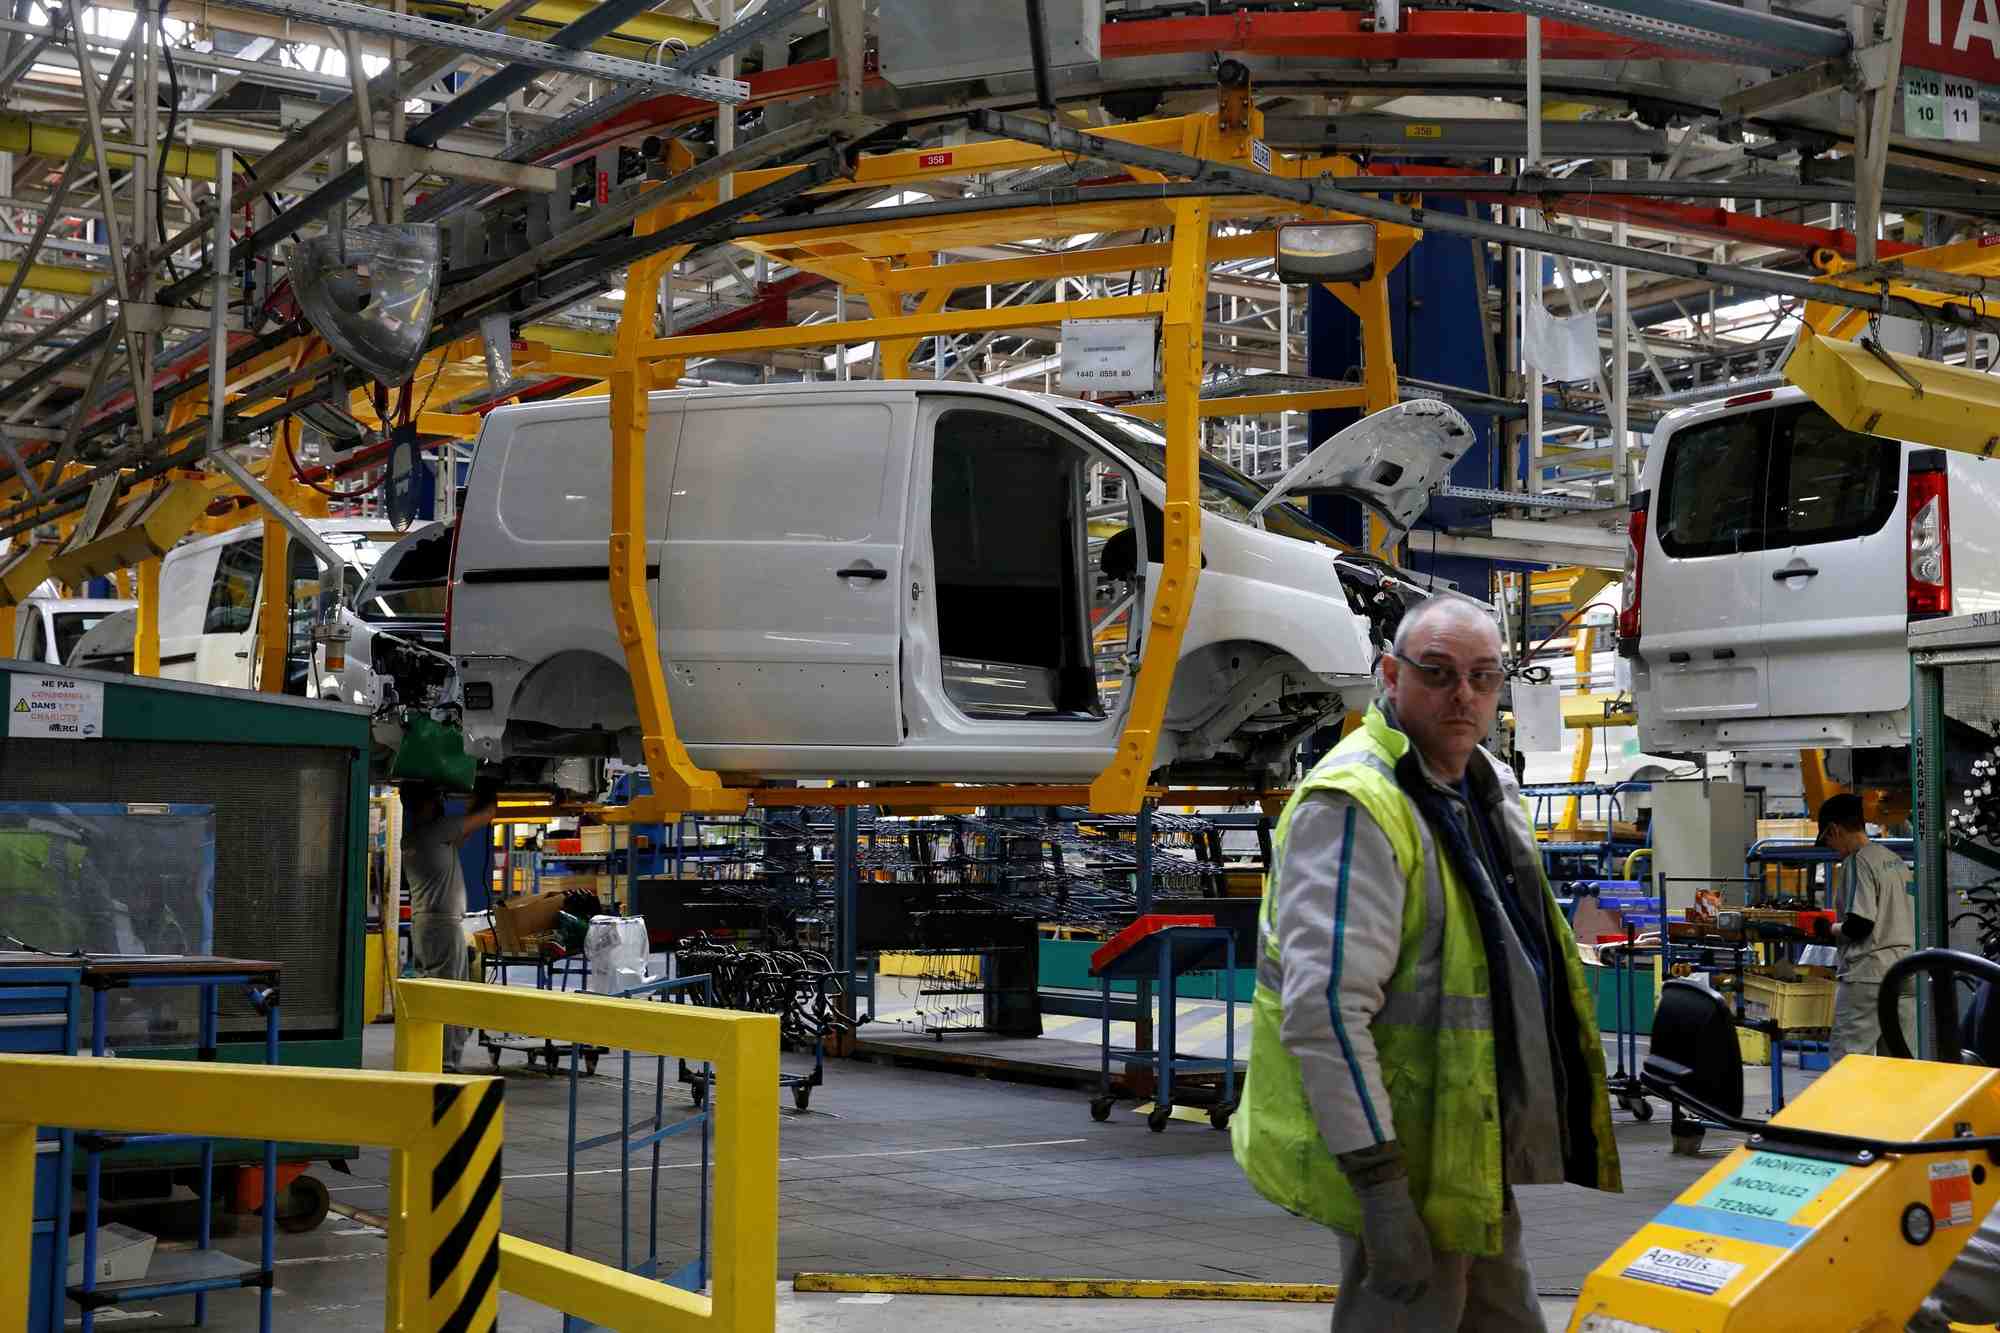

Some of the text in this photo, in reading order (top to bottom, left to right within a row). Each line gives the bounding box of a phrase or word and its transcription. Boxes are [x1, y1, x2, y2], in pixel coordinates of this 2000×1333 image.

[1910, 80, 1939, 96] M1D
[1945, 83, 1974, 99] M1D
[1917, 106, 1934, 121] 10
[1953, 108, 1968, 123] 11
[41, 680, 75, 689] NE PAS
[31, 701, 56, 710] DANS
[48, 723, 78, 733] MERCI
[1751, 1155, 1837, 1178] MONITEUR
